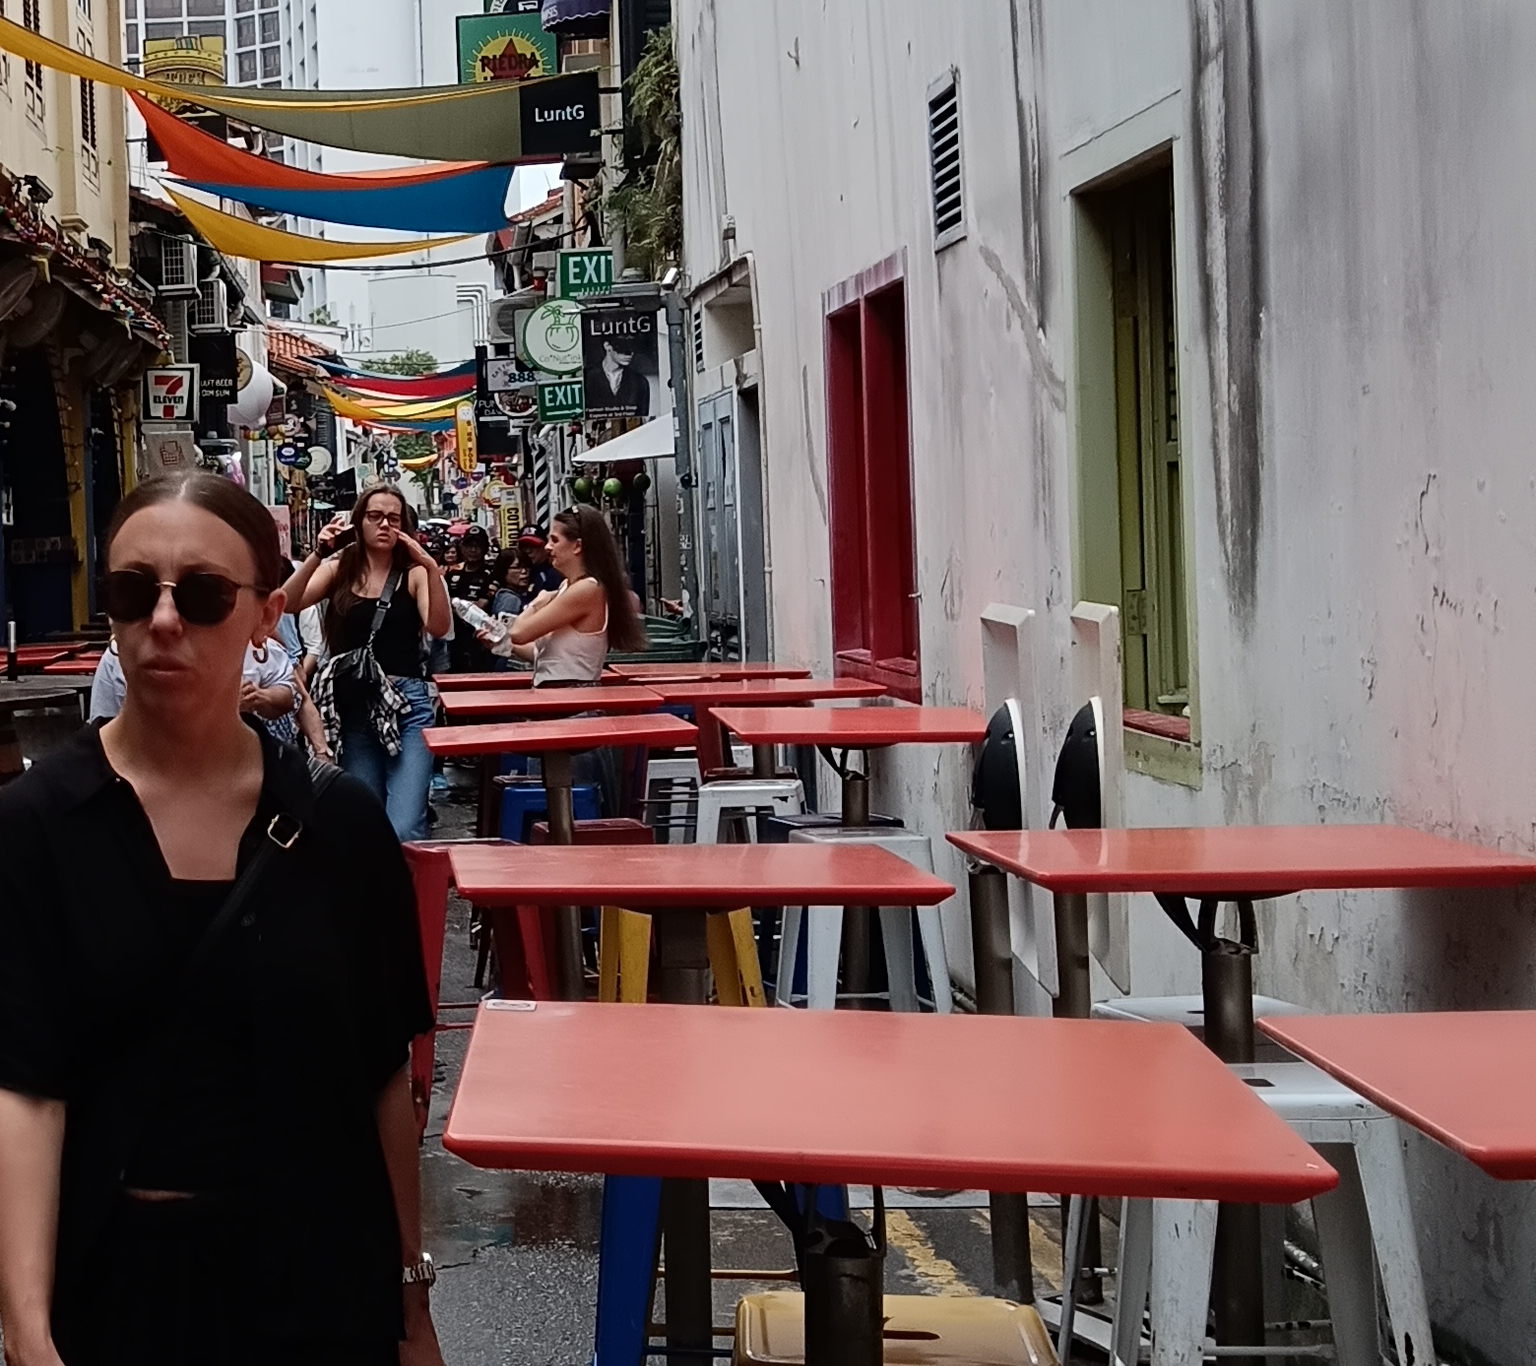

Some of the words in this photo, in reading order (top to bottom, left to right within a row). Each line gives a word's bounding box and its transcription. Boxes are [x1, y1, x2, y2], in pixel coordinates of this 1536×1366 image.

[480, 51, 540, 72] PIEDRA
[508, 370, 536, 383] 888
[544, 383, 582, 407] EXIT
